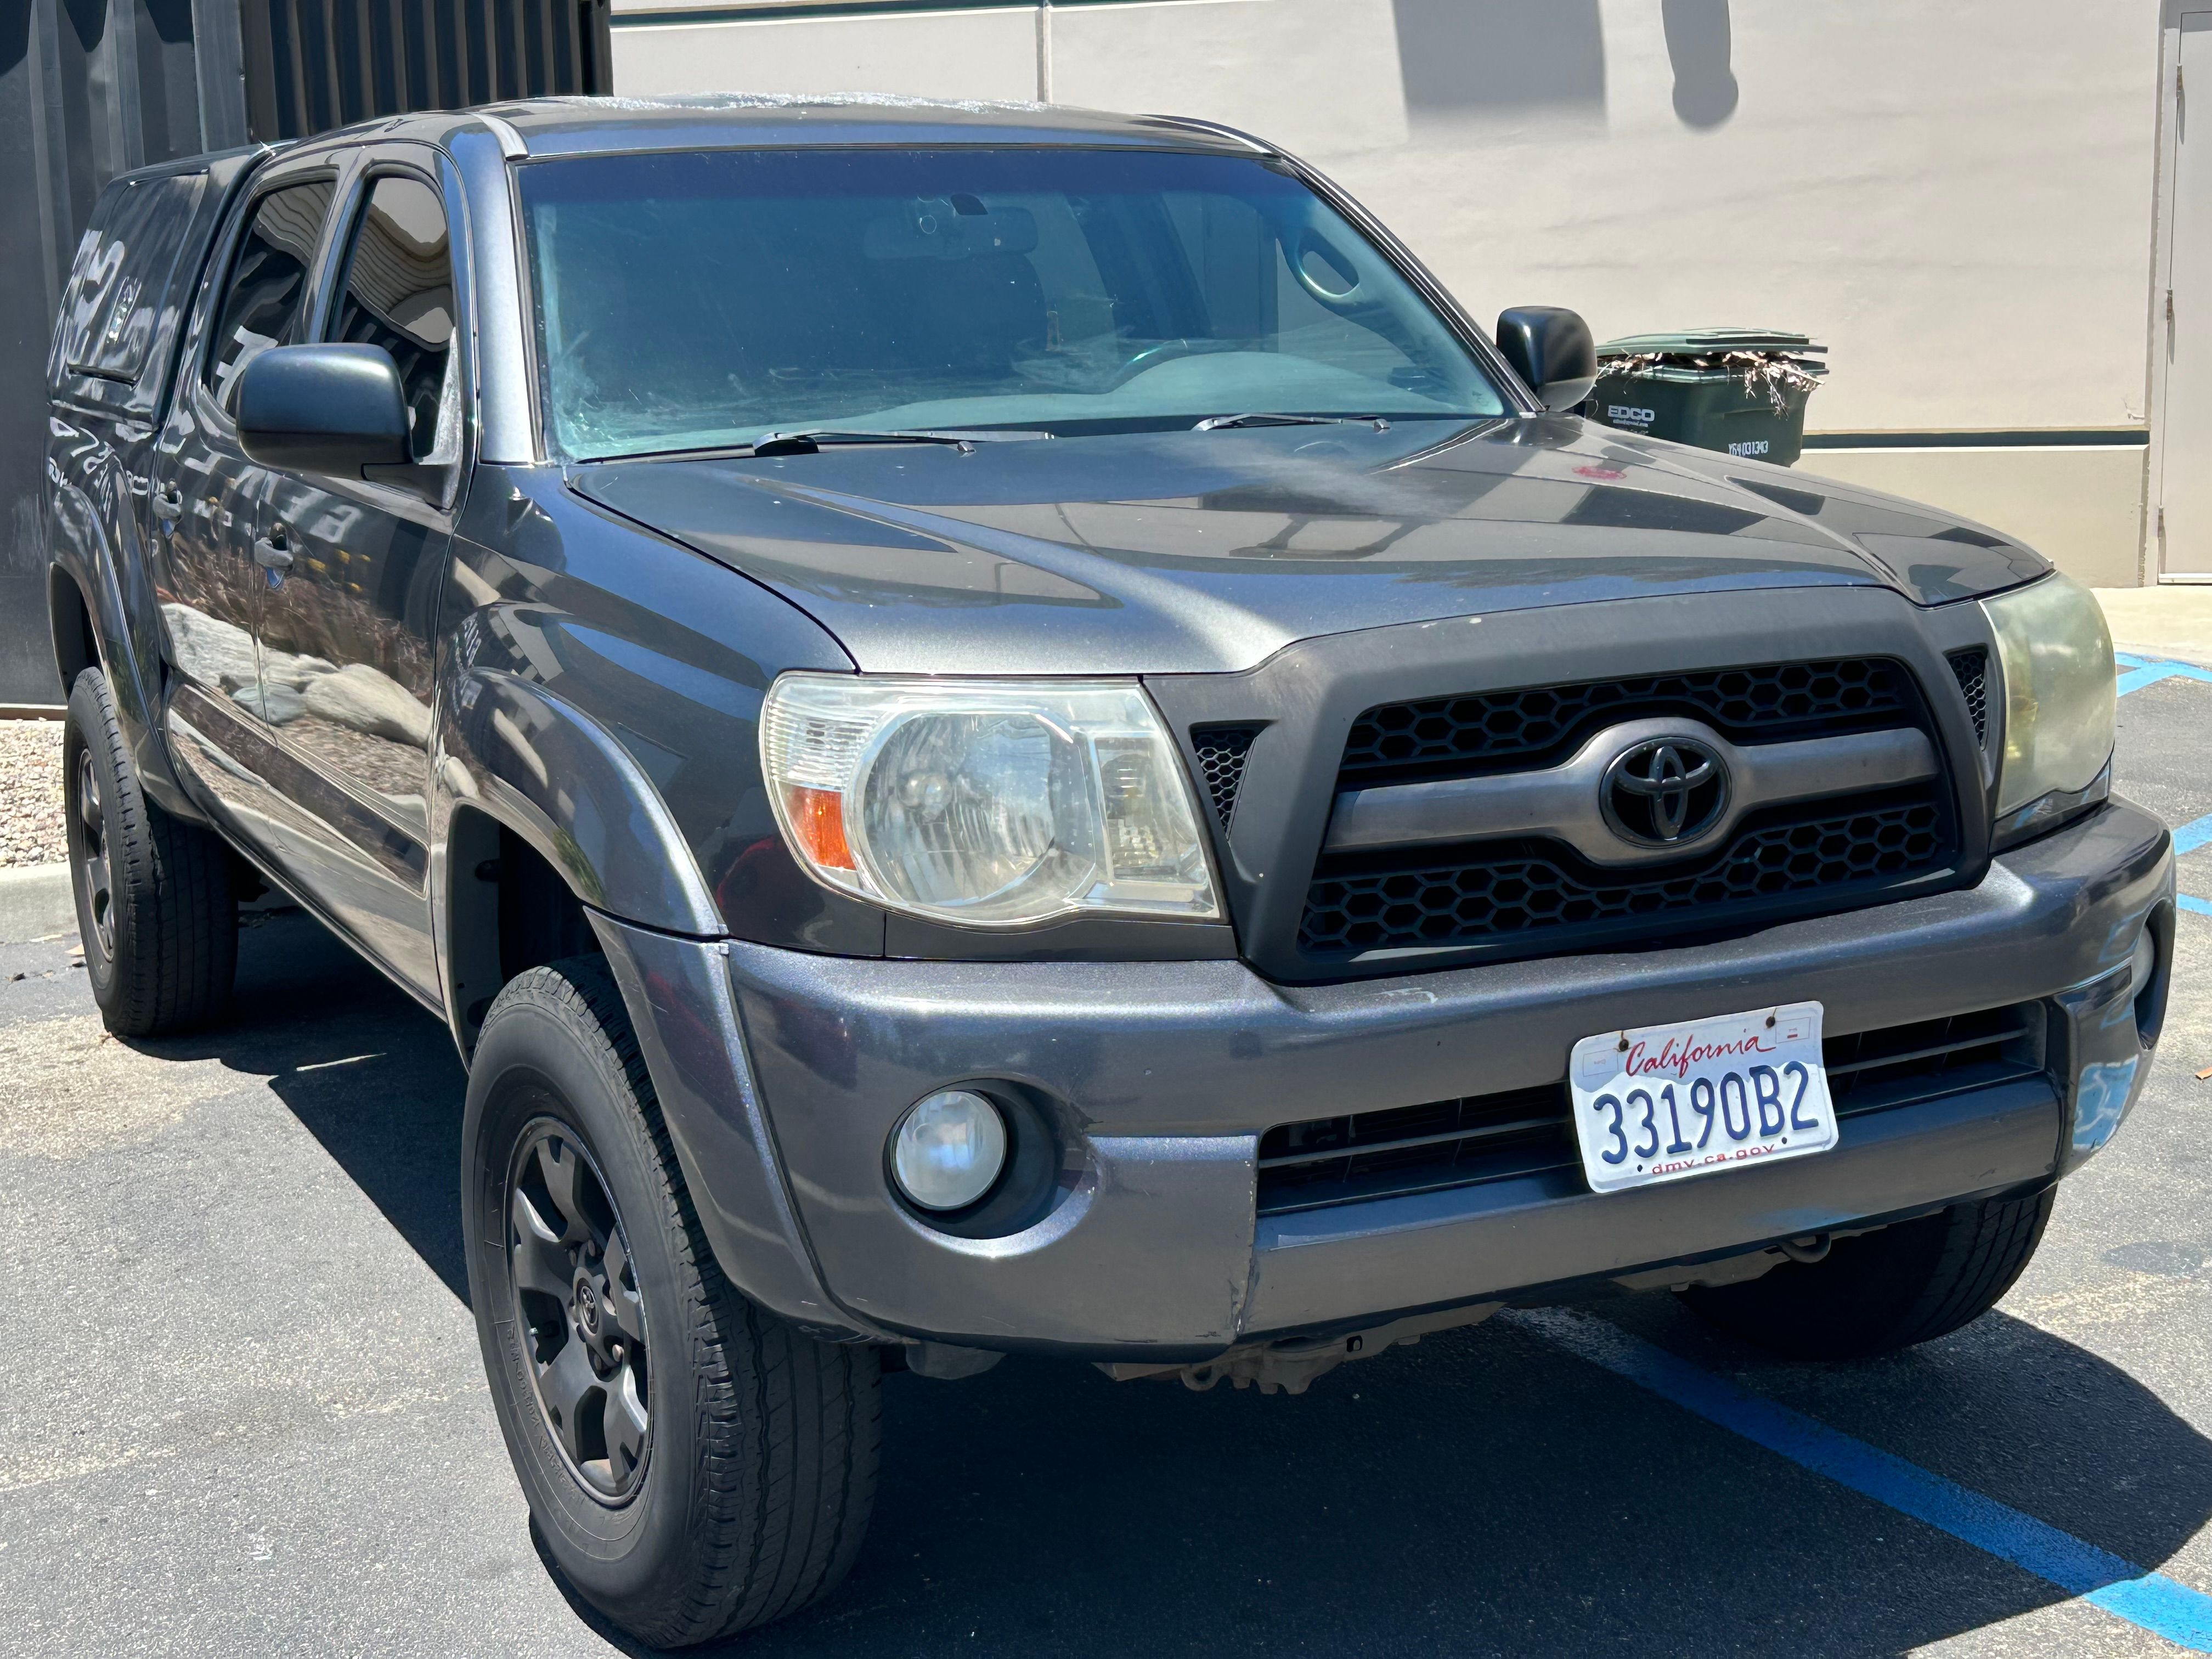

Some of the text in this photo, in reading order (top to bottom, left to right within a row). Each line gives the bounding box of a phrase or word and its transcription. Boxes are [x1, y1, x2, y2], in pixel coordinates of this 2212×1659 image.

[1607, 405, 1655, 422] EDCO
[1626, 1028, 1776, 1079] California
[1593, 1060, 1819, 1165] 33190B2
[1652, 1143, 1775, 1175] dmv.ca.gov
